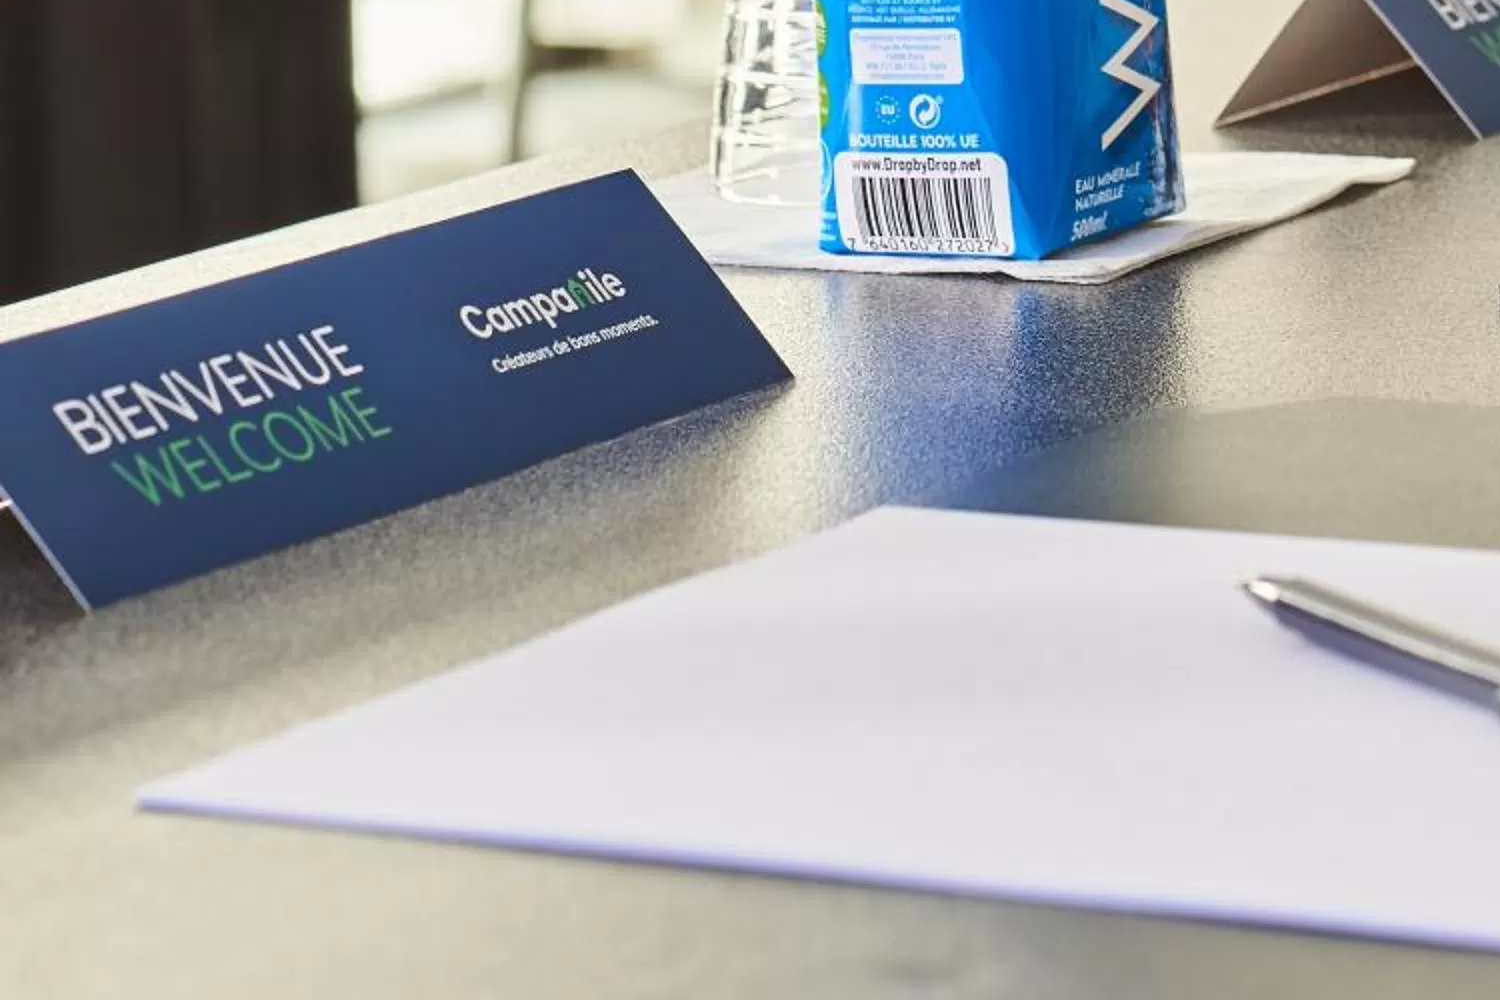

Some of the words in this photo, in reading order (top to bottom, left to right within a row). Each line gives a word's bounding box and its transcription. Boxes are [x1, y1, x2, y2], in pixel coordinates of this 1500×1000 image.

[850, 134, 918, 148] BOUTEILLE
[920, 134, 957, 149] 100%
[959, 134, 981, 148] UE
[850, 156, 982, 174] www.DropbyDrop.net
[1075, 175, 1096, 195] EAU
[459, 268, 627, 339] Campanile
[553, 338, 571, 356] de
[567, 330, 602, 350] bons
[52, 325, 364, 455] BIENVENUE
[110, 387, 393, 506] WELCOME
